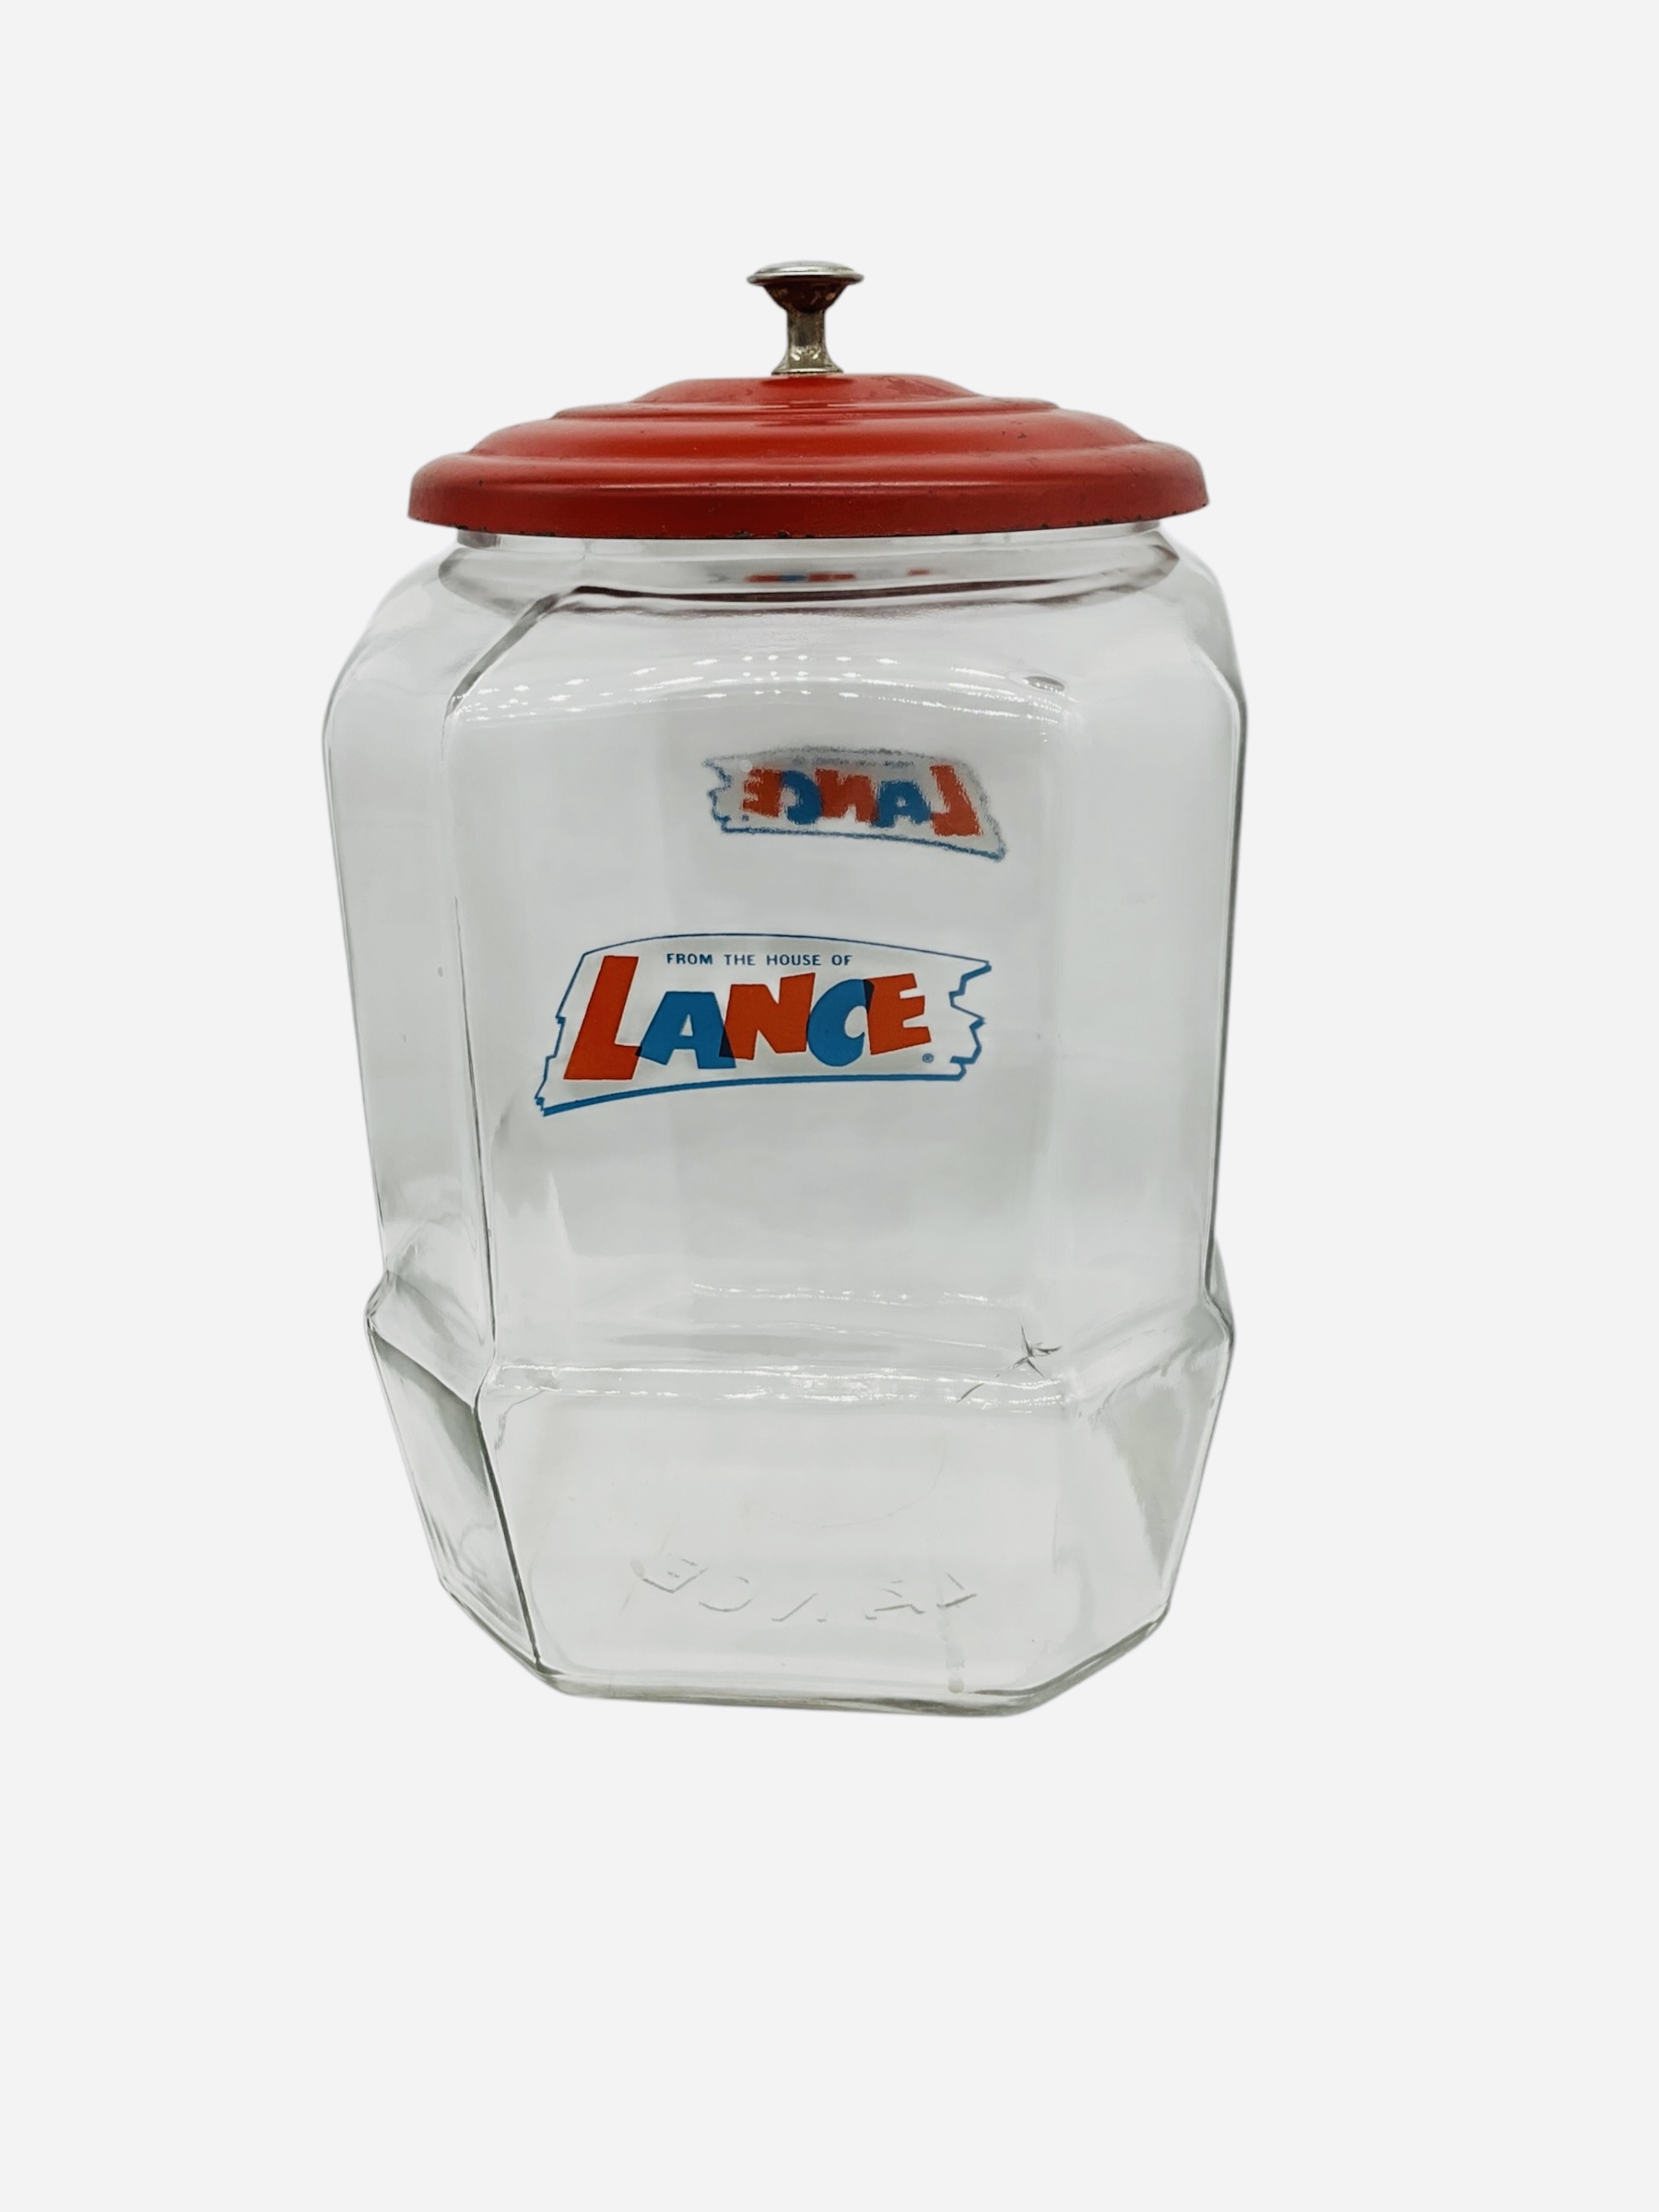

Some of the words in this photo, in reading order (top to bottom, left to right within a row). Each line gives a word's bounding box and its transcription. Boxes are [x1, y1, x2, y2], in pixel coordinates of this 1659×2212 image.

[665, 952, 714, 966] FROM
[724, 953, 757, 967] THE
[766, 953, 822, 967] HOUSE
[831, 953, 853, 967] OF
[563, 956, 932, 1081] LANCE
